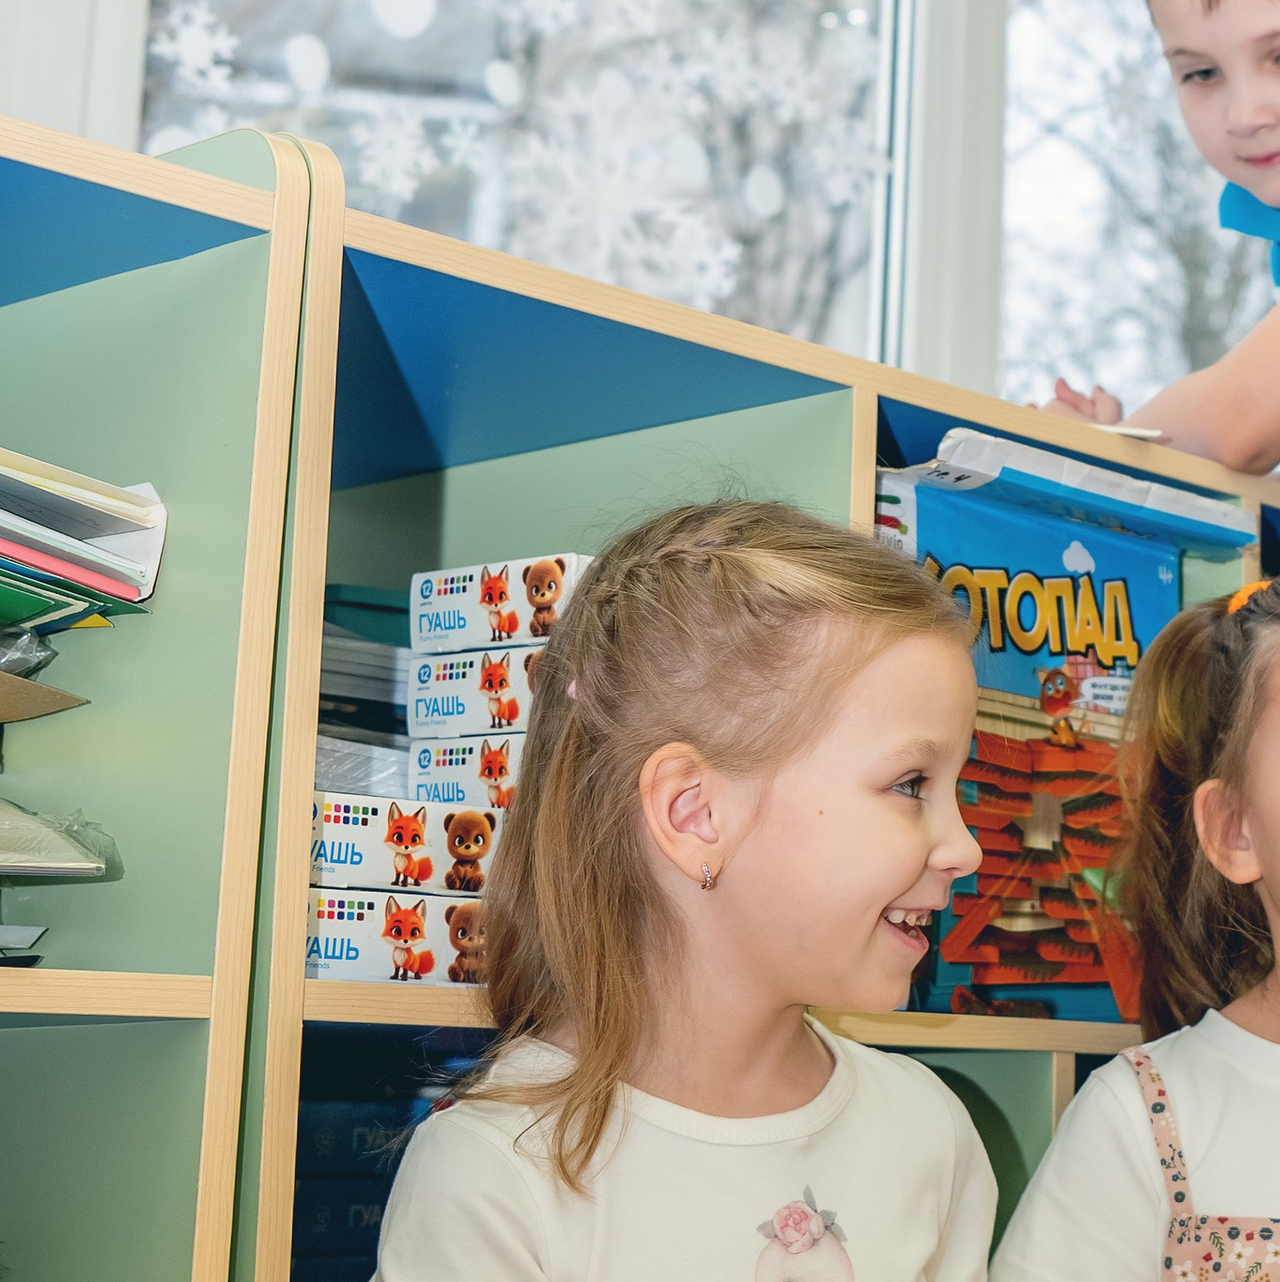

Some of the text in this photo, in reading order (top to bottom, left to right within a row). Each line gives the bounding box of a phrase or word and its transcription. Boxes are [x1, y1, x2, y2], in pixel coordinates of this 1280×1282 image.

[418, 610, 467, 634] ГУАШЬ
[924, 555, 1139, 667] ОТОПАД
[415, 695, 466, 719] ГУАШЬ
[416, 782, 466, 803] ГУАШЬ
[306, 935, 360, 960] АШЬ
